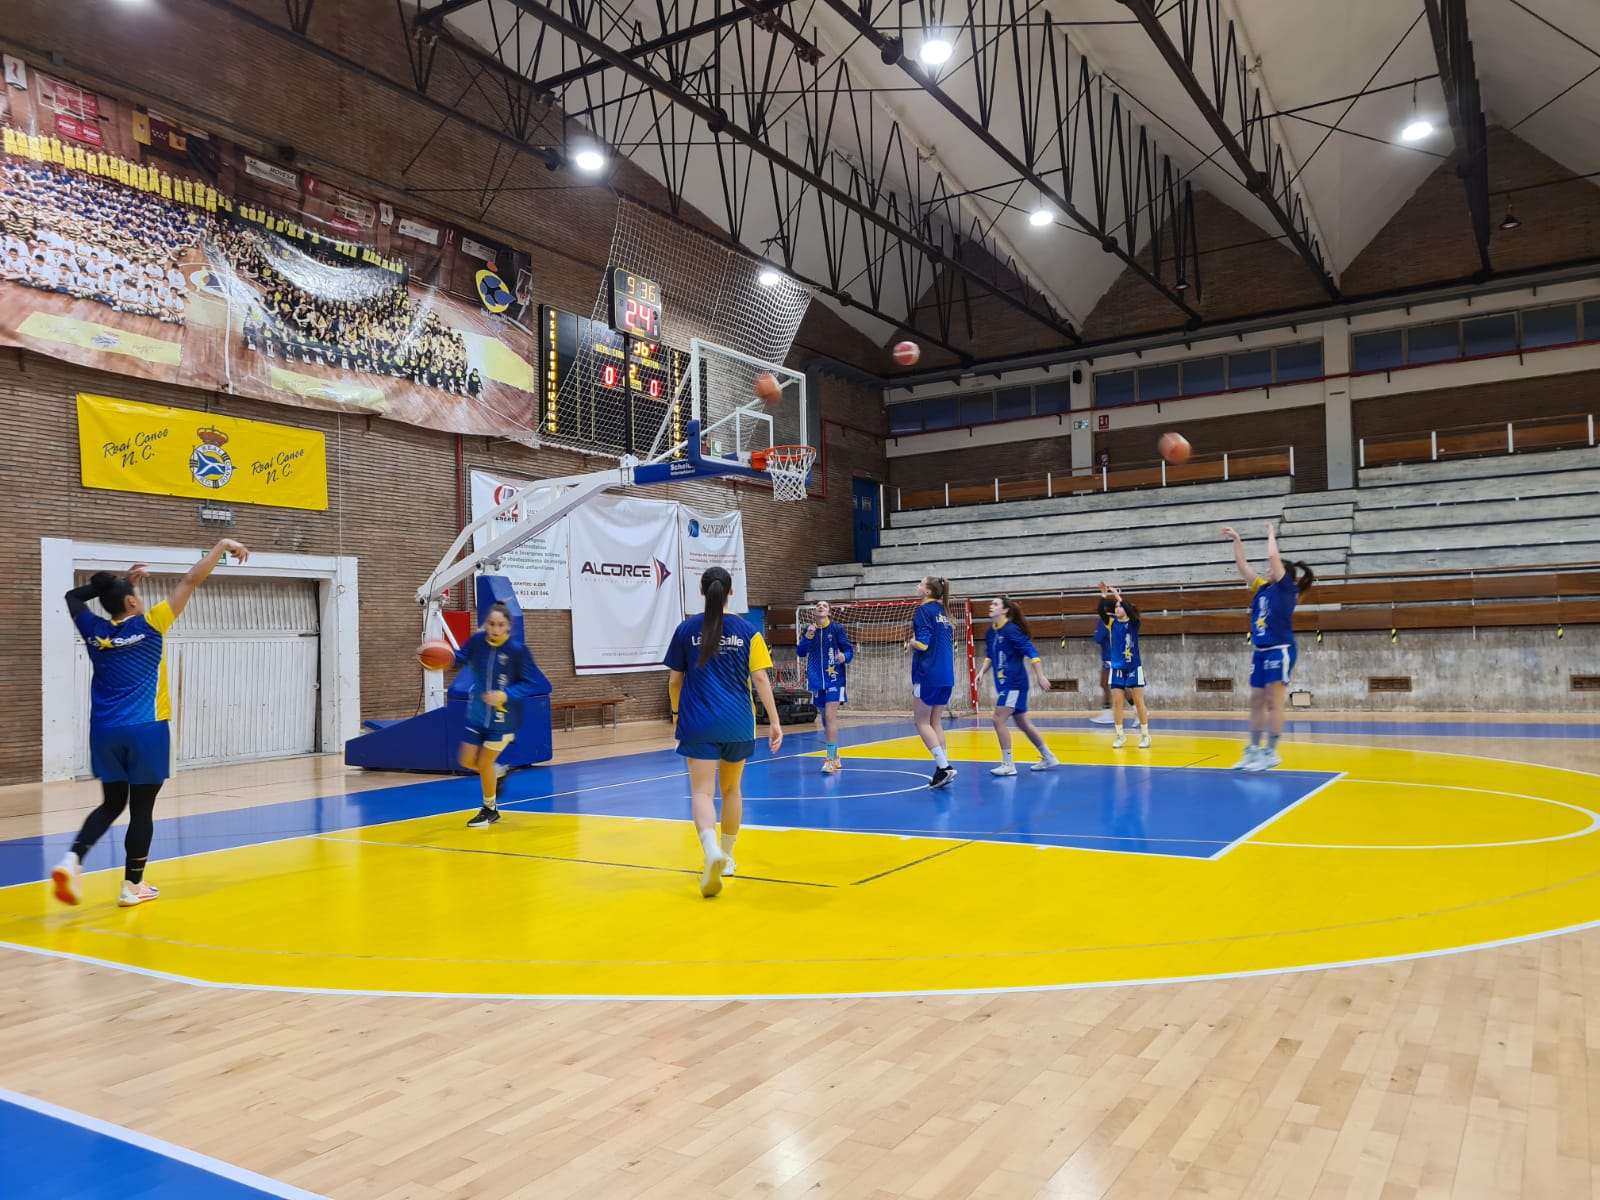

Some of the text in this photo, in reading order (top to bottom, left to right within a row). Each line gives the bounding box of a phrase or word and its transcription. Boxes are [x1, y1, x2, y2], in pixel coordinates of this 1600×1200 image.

[269, 166, 294, 181] MOVESA
[627, 276, 656, 303] 9:36
[625, 298, 651, 331] 24
[605, 365, 614, 385] 0
[628, 364, 637, 379] 2
[650, 379, 658, 397] 0
[103, 428, 168, 458] Real Canoe
[142, 445, 155, 460] C.
[251, 449, 304, 476] Real Canoe
[282, 463, 293, 477] C.
[581, 561, 651, 578] ALCORCE
[113, 634, 146, 647] Salle
[719, 635, 744, 647] Salle
